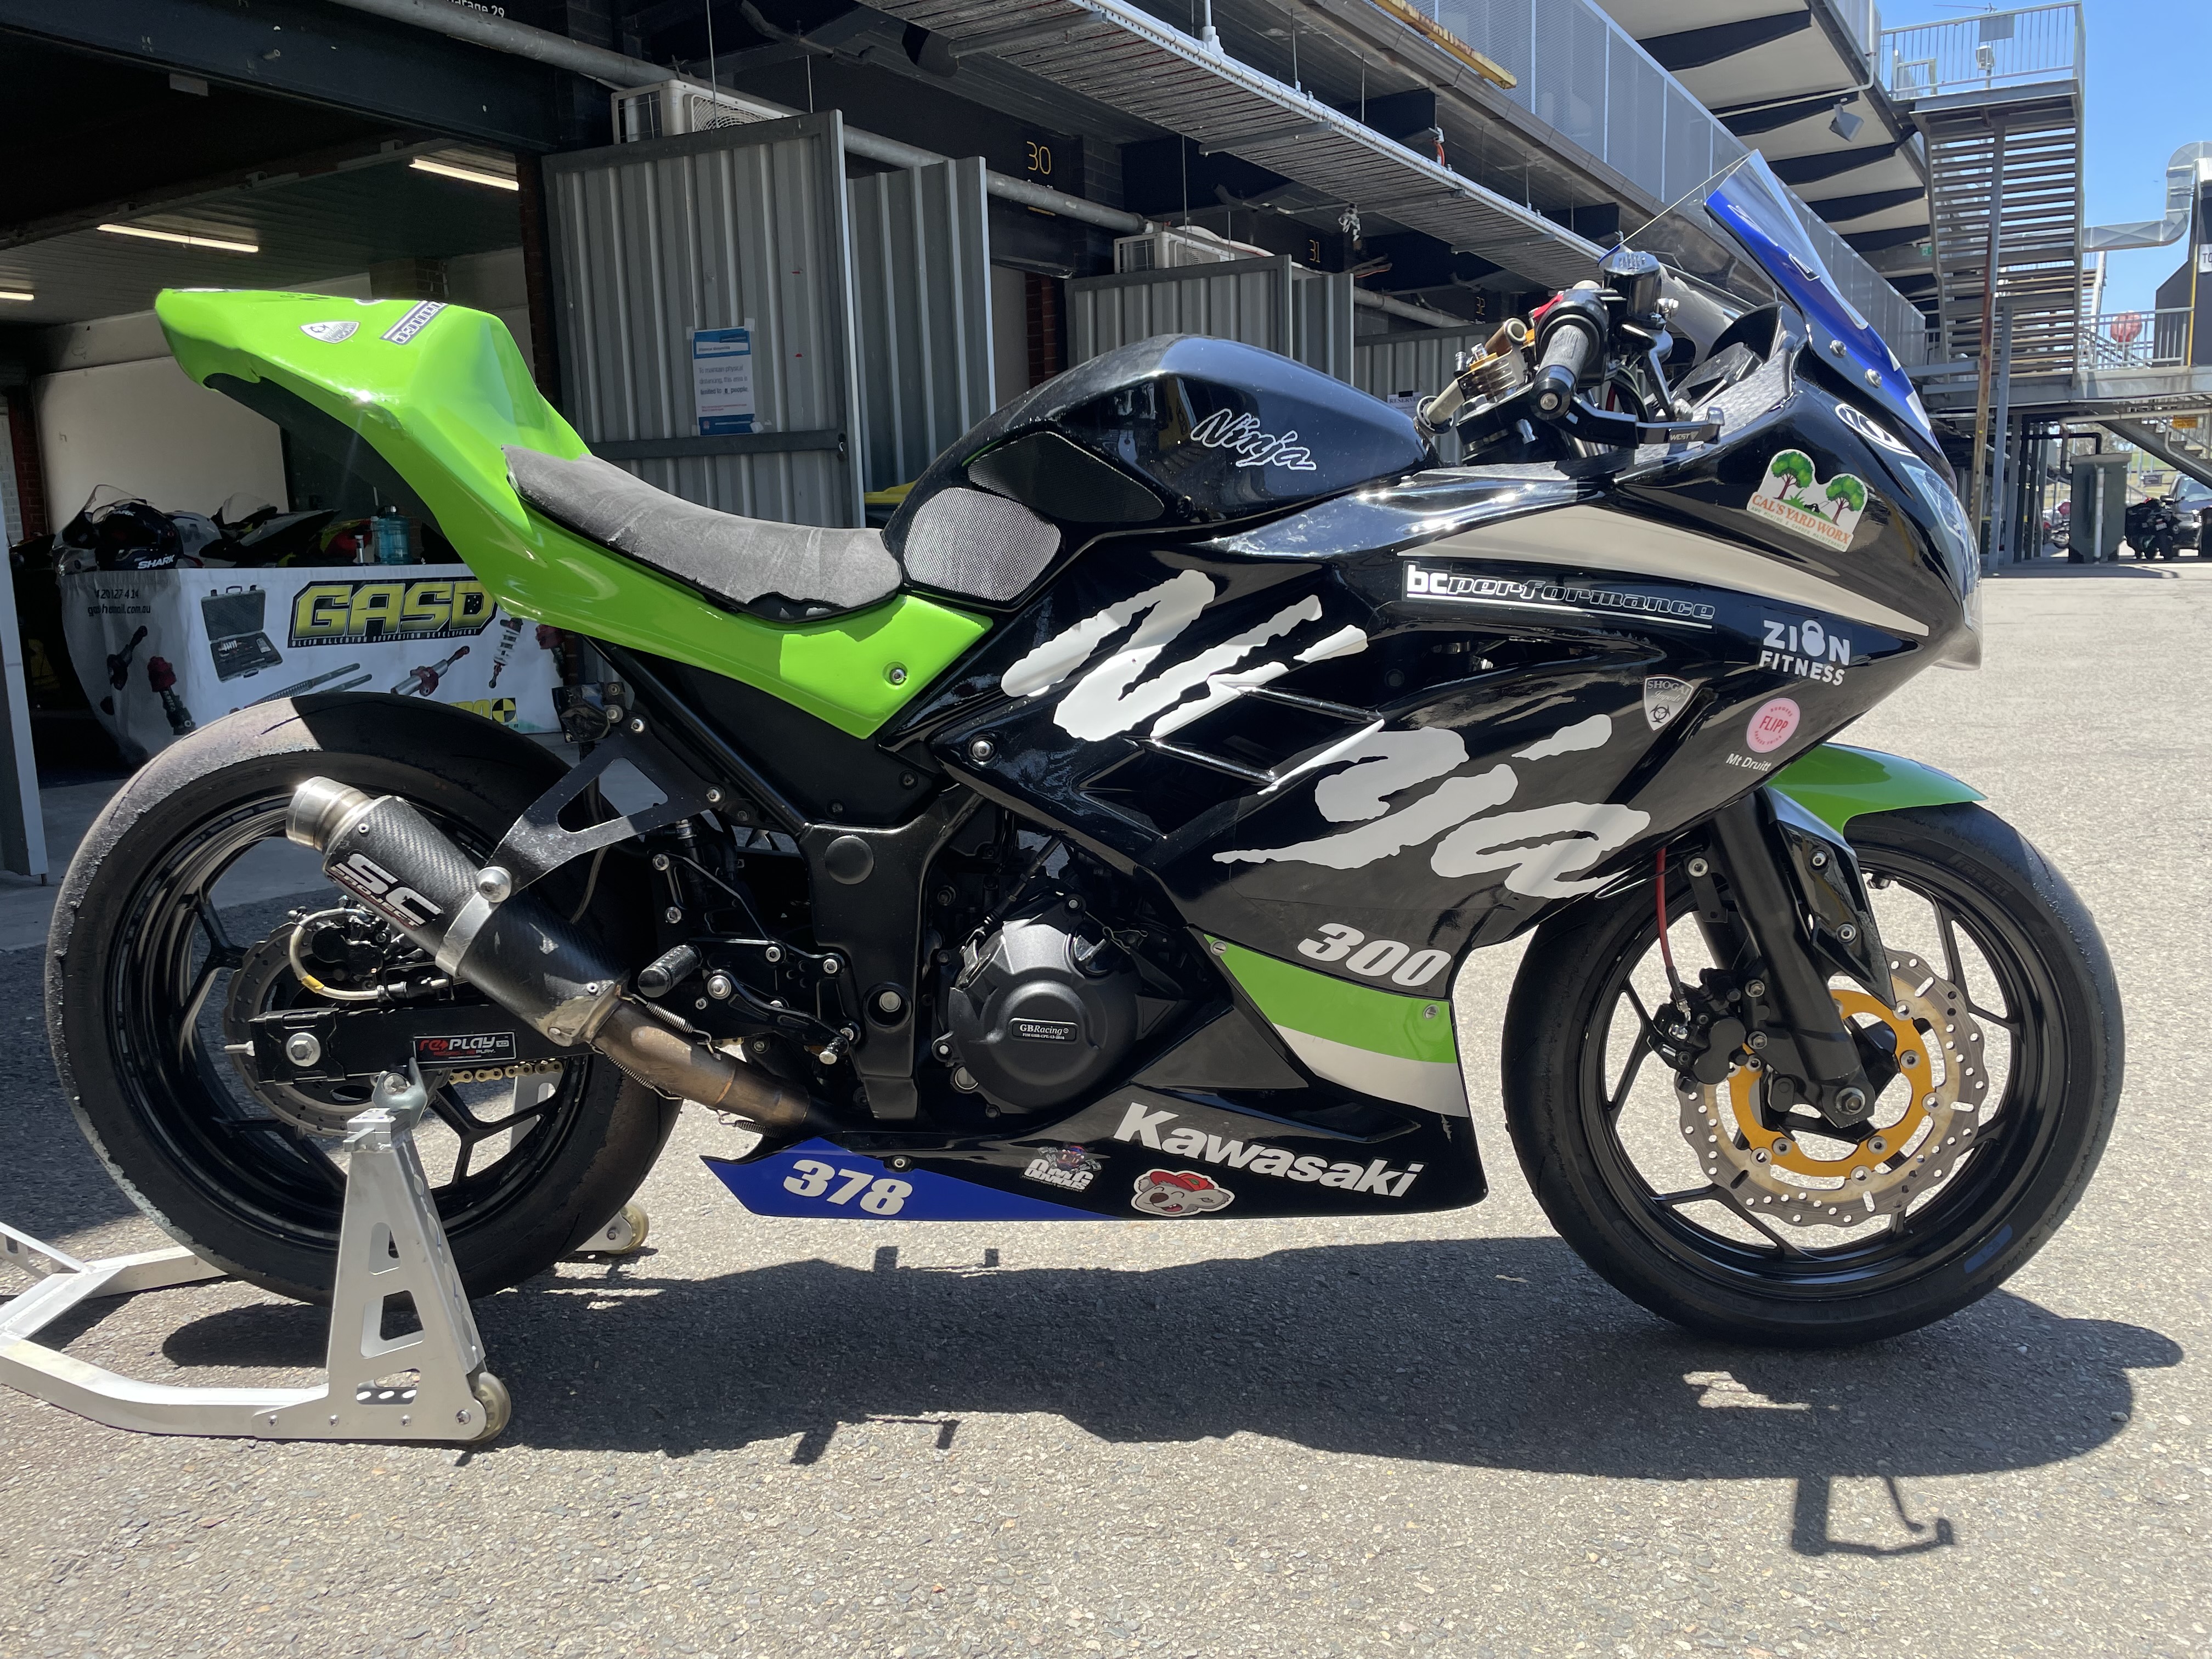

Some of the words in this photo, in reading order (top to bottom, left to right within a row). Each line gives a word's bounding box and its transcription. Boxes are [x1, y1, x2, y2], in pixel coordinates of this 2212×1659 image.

[1026, 141, 1052, 174] 30
[1309, 239, 1321, 263] 31
[1190, 408, 1317, 471] Ninja
[1670, 433, 1691, 441] WEST
[1752, 494, 1786, 517] CAL'S
[1785, 508, 1816, 528] YARD
[1816, 521, 1852, 545] WORX
[137, 554, 175, 569] SHARK
[291, 580, 496, 640] GASD
[1763, 619, 1851, 666] ZION
[1646, 680, 1690, 696] SHOGAI
[1758, 650, 1846, 686] FITNESS
[1652, 690, 1681, 704] Imports
[1758, 715, 1790, 734] FLIPP
[1726, 753, 1742, 766] Mt
[1741, 757, 1772, 772] Druitt
[329, 863, 425, 928] PROJECT
[346, 853, 445, 926] SC
[1949, 853, 2015, 898] PIRELLI
[1296, 922, 1453, 988] 300
[1113, 1102, 1425, 1198] Kawasaki
[782, 1159, 914, 1216] 378
